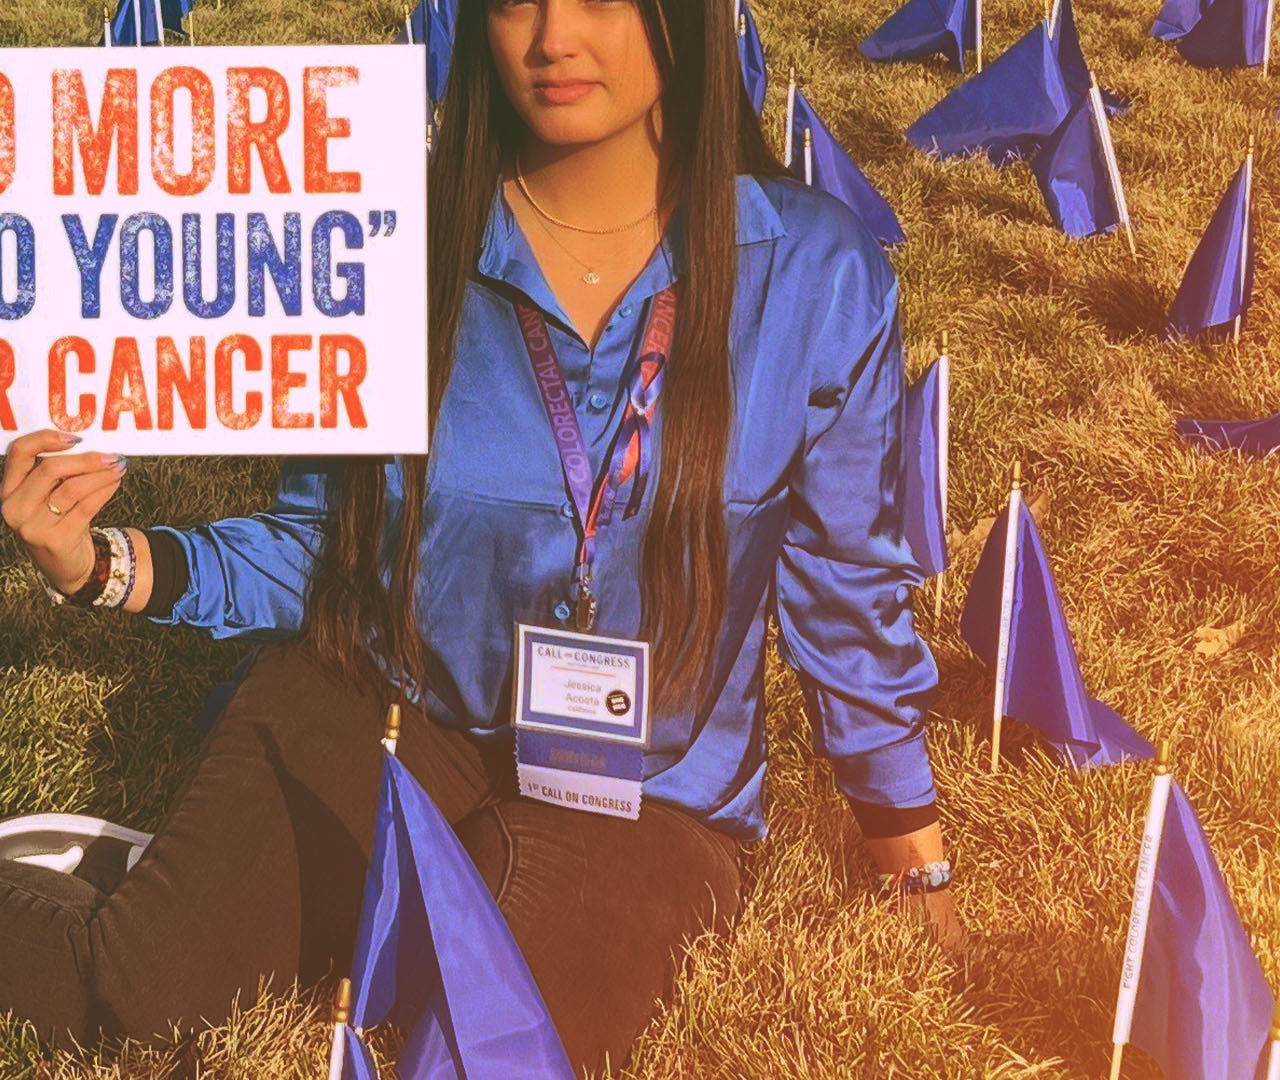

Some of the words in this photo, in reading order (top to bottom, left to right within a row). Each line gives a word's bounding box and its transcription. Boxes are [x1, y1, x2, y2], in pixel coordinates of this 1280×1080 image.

[51, 65, 362, 196] MORE
[61, 210, 397, 320] YOUNG”
[47, 333, 369, 433] CANCER
[536, 354, 590, 484] COLORECTAL
[537, 646, 563, 660] CALL
[574, 652, 631, 669] CONGRESS
[541, 786, 563, 801] CALL
[565, 791, 580, 804] ON
[581, 793, 632, 814] CONGRESS
